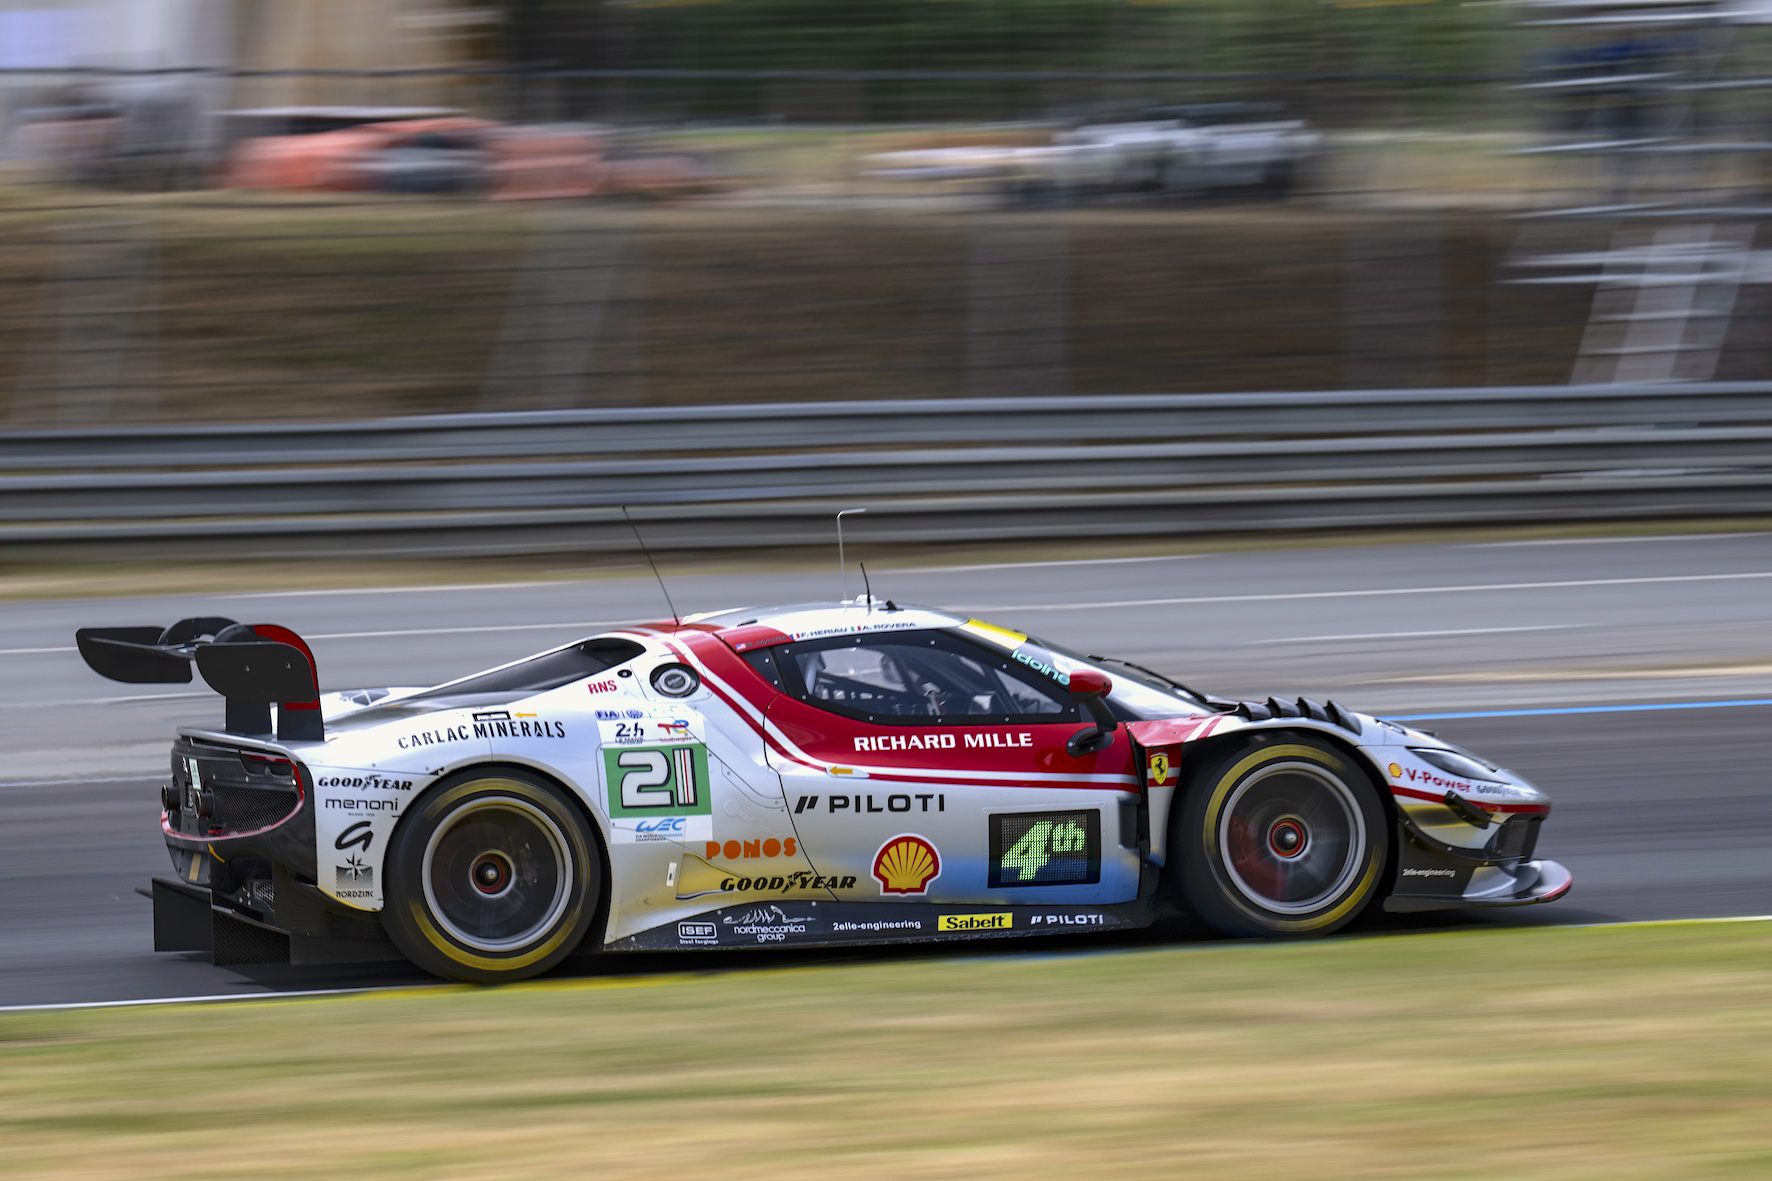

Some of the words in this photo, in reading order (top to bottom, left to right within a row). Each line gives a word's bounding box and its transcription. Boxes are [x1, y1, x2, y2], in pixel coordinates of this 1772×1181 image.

[588, 680, 617, 695] RNS
[398, 725, 469, 749] CARLAC
[473, 720, 566, 739] MINERALS
[854, 734, 956, 751] RICHARD
[964, 733, 1033, 748] MILLE
[318, 777, 413, 791] GOODYEAR
[618, 748, 698, 809] 21
[1405, 768, 1472, 792] V-Power
[325, 798, 398, 811] menoni
[829, 794, 945, 813] PILOTI
[636, 818, 687, 832] WEC
[706, 837, 797, 860] PONOS
[720, 873, 857, 892] GOODYEAR
[336, 890, 374, 898] NORDZINC
[833, 920, 922, 931] 2elle-engineering
[946, 915, 1004, 929] Sabelt
[1047, 915, 1104, 926] PILOTI
[682, 925, 713, 935] ISEF
[734, 924, 806, 934] nordmeccanica
[757, 933, 785, 943] group
